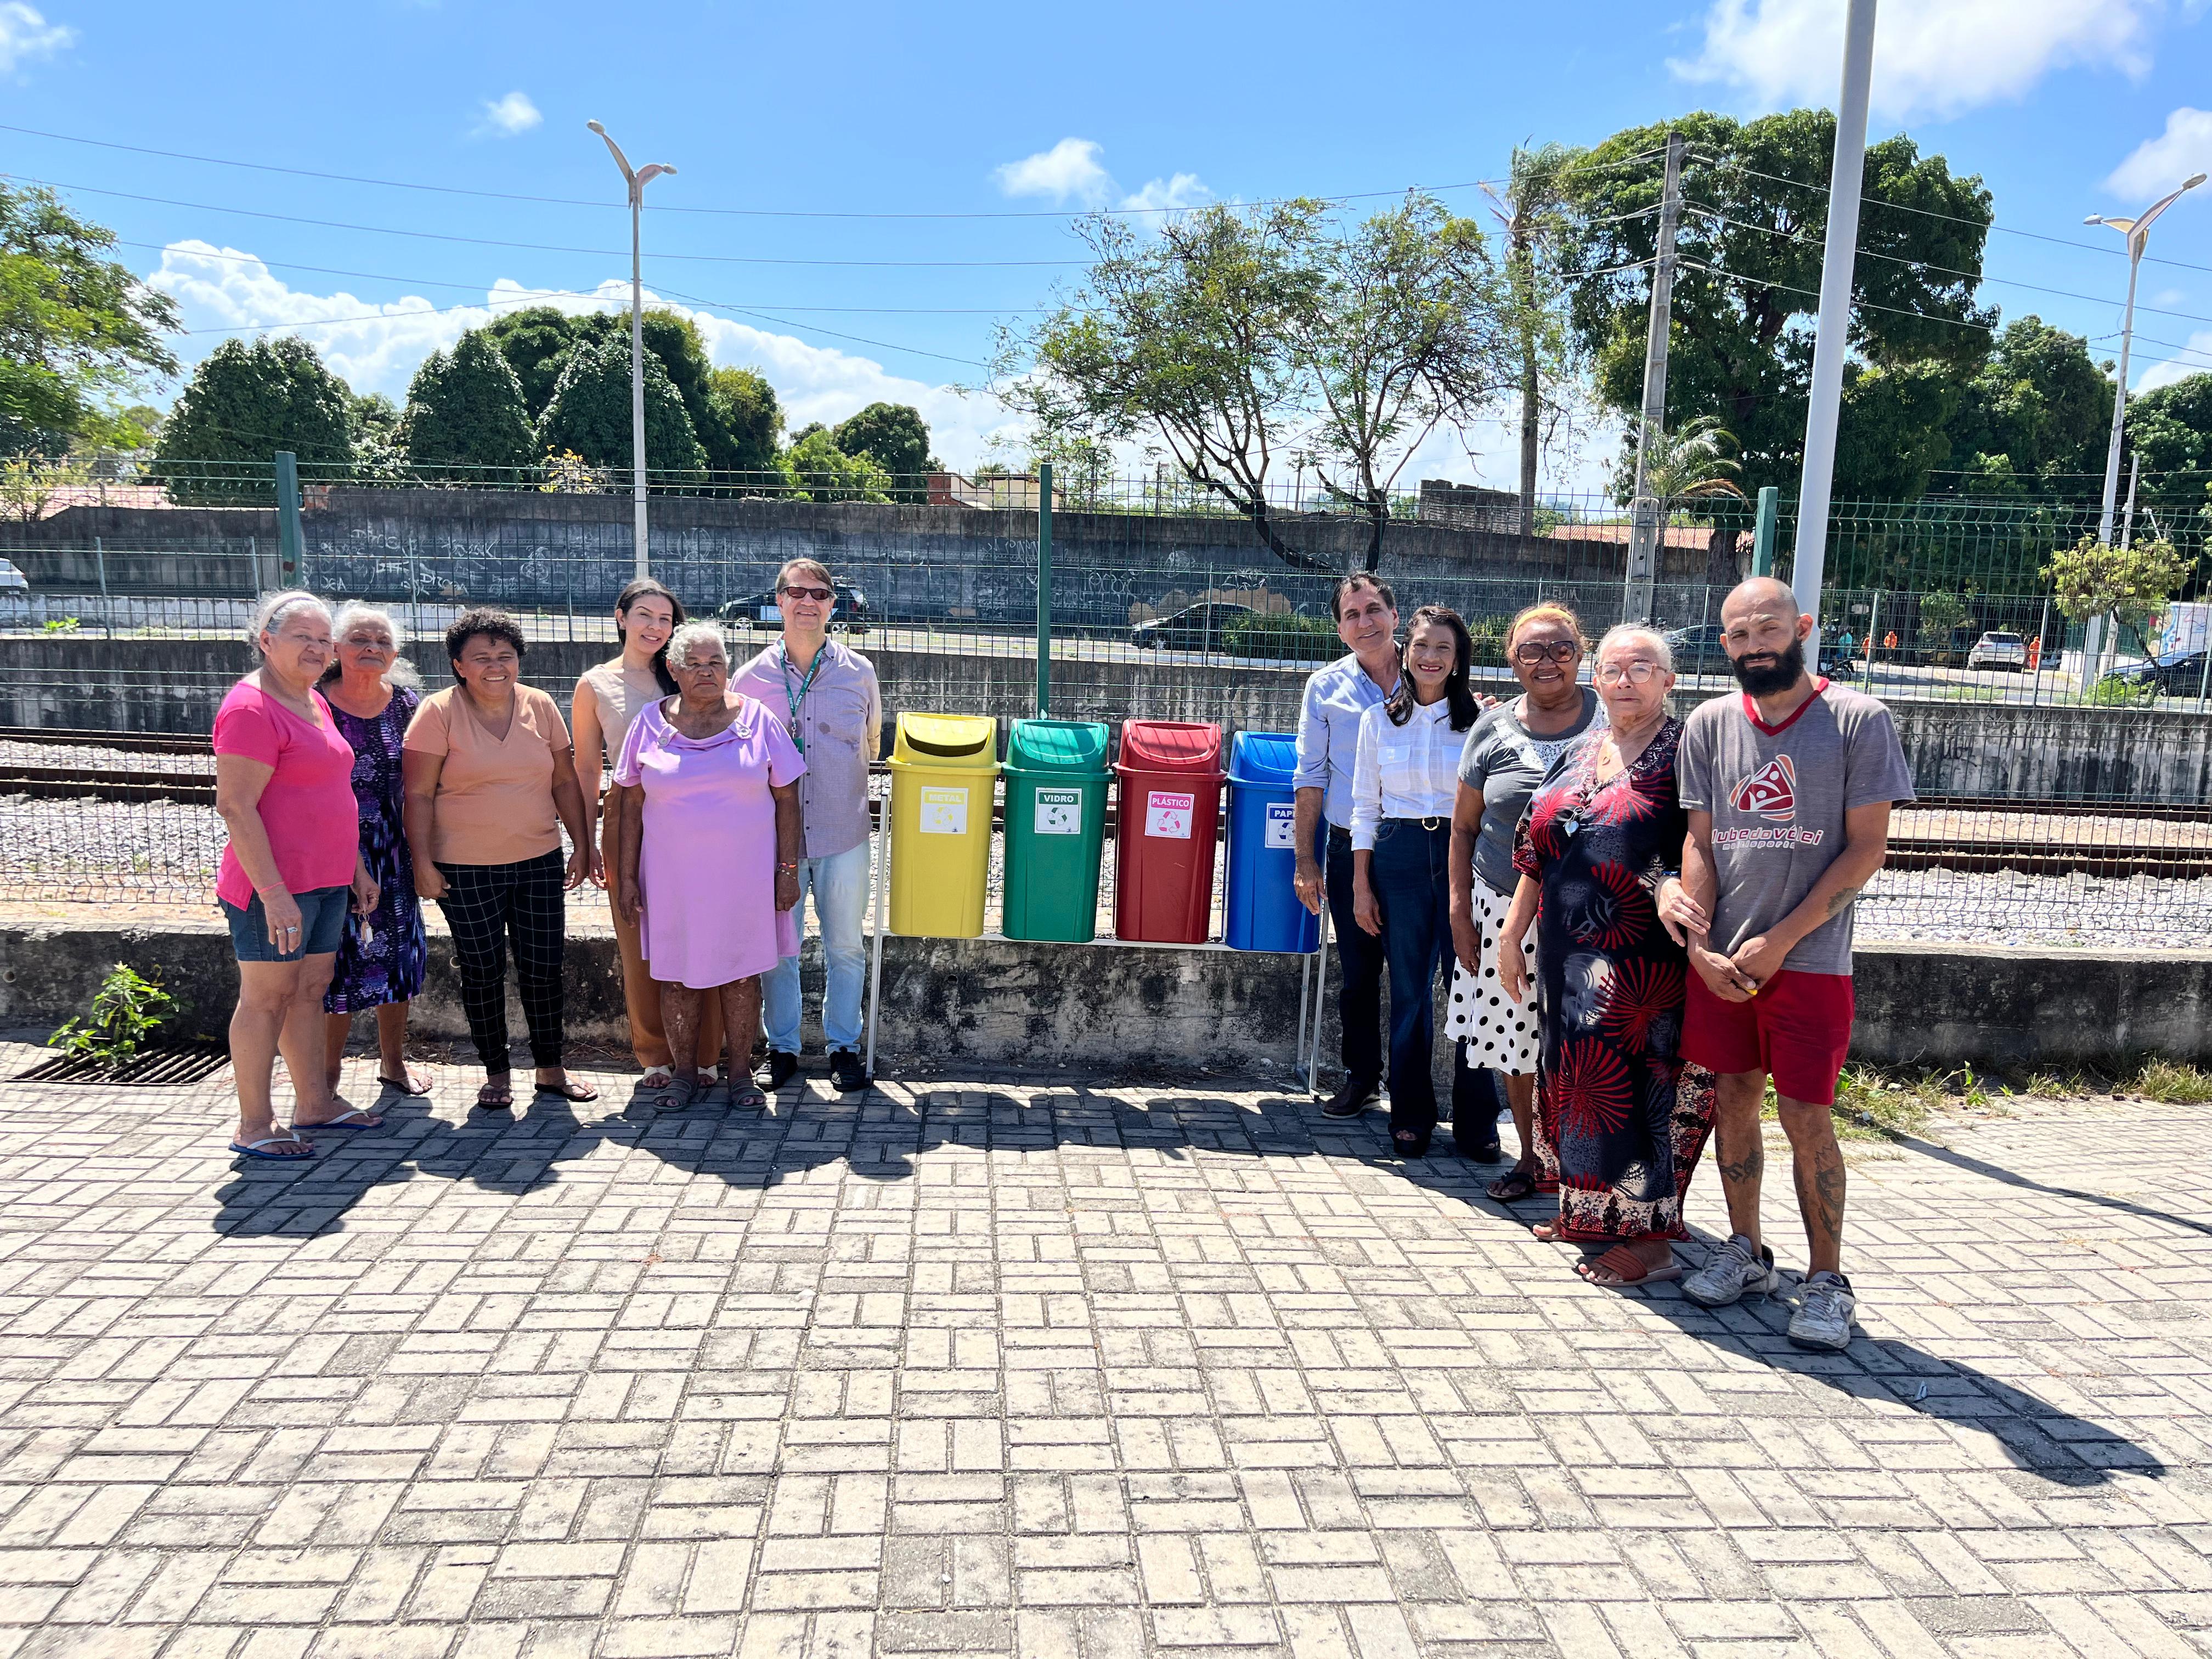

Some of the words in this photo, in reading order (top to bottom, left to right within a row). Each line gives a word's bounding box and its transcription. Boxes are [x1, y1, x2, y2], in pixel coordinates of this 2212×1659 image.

[929, 794, 962, 802] METAL
[1043, 794, 1074, 803] VIDRO
[1152, 797, 1189, 808] PLÁSTICO
